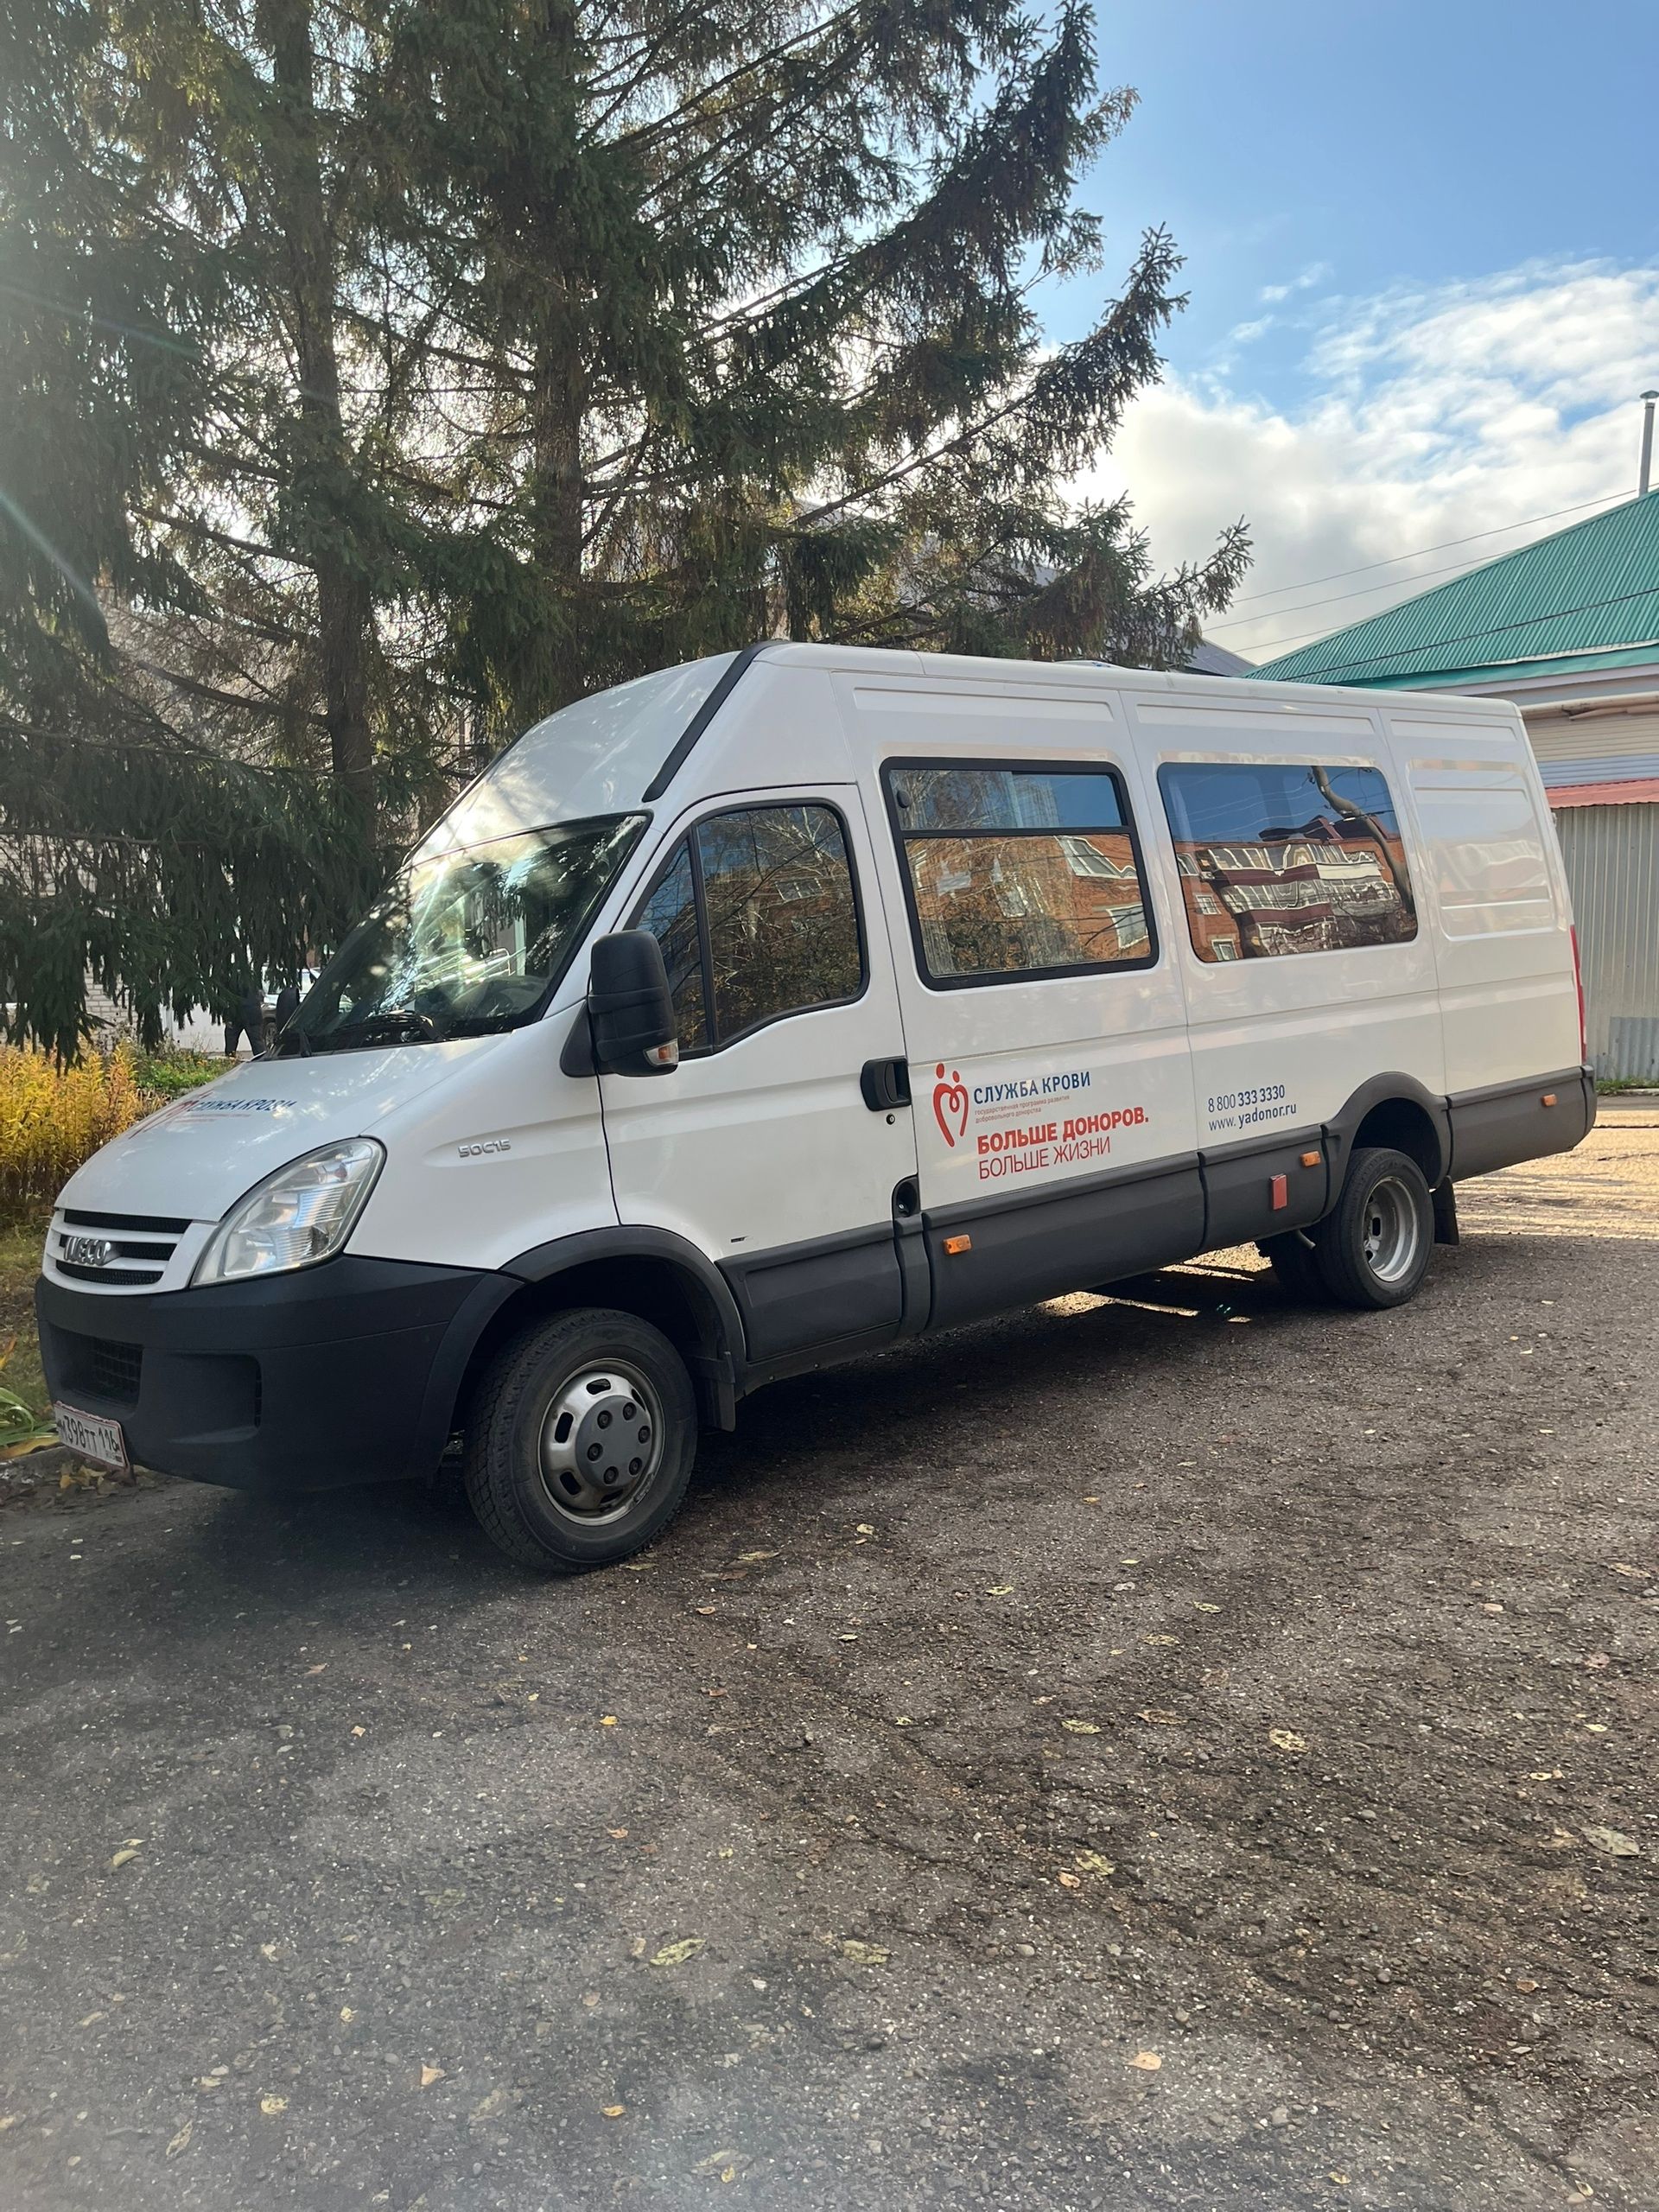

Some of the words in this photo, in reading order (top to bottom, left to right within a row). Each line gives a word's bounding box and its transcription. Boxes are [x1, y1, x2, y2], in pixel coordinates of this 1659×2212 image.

[973, 1079, 1039, 1105] СЛУЖБА
[1042, 1071, 1090, 1094] КРОВИ
[1208, 1097, 1215, 1113] 8
[1217, 1093, 1236, 1111] 800
[1237, 1090, 1257, 1107] 333
[1259, 1084, 1286, 1103] 3330
[977, 1122, 1058, 1155] БОЛЬШЕ
[1063, 1106, 1149, 1142] ДОНОРОВ.
[1209, 1116, 1236, 1131] www.
[1238, 1103, 1297, 1129] yadonor.ru
[458, 1139, 512, 1158] 50C15
[979, 1146, 1049, 1179] БОЛЬШЕ
[1053, 1136, 1110, 1164] ЖИЗНИ
[64, 1236, 109, 1267] IVECO
